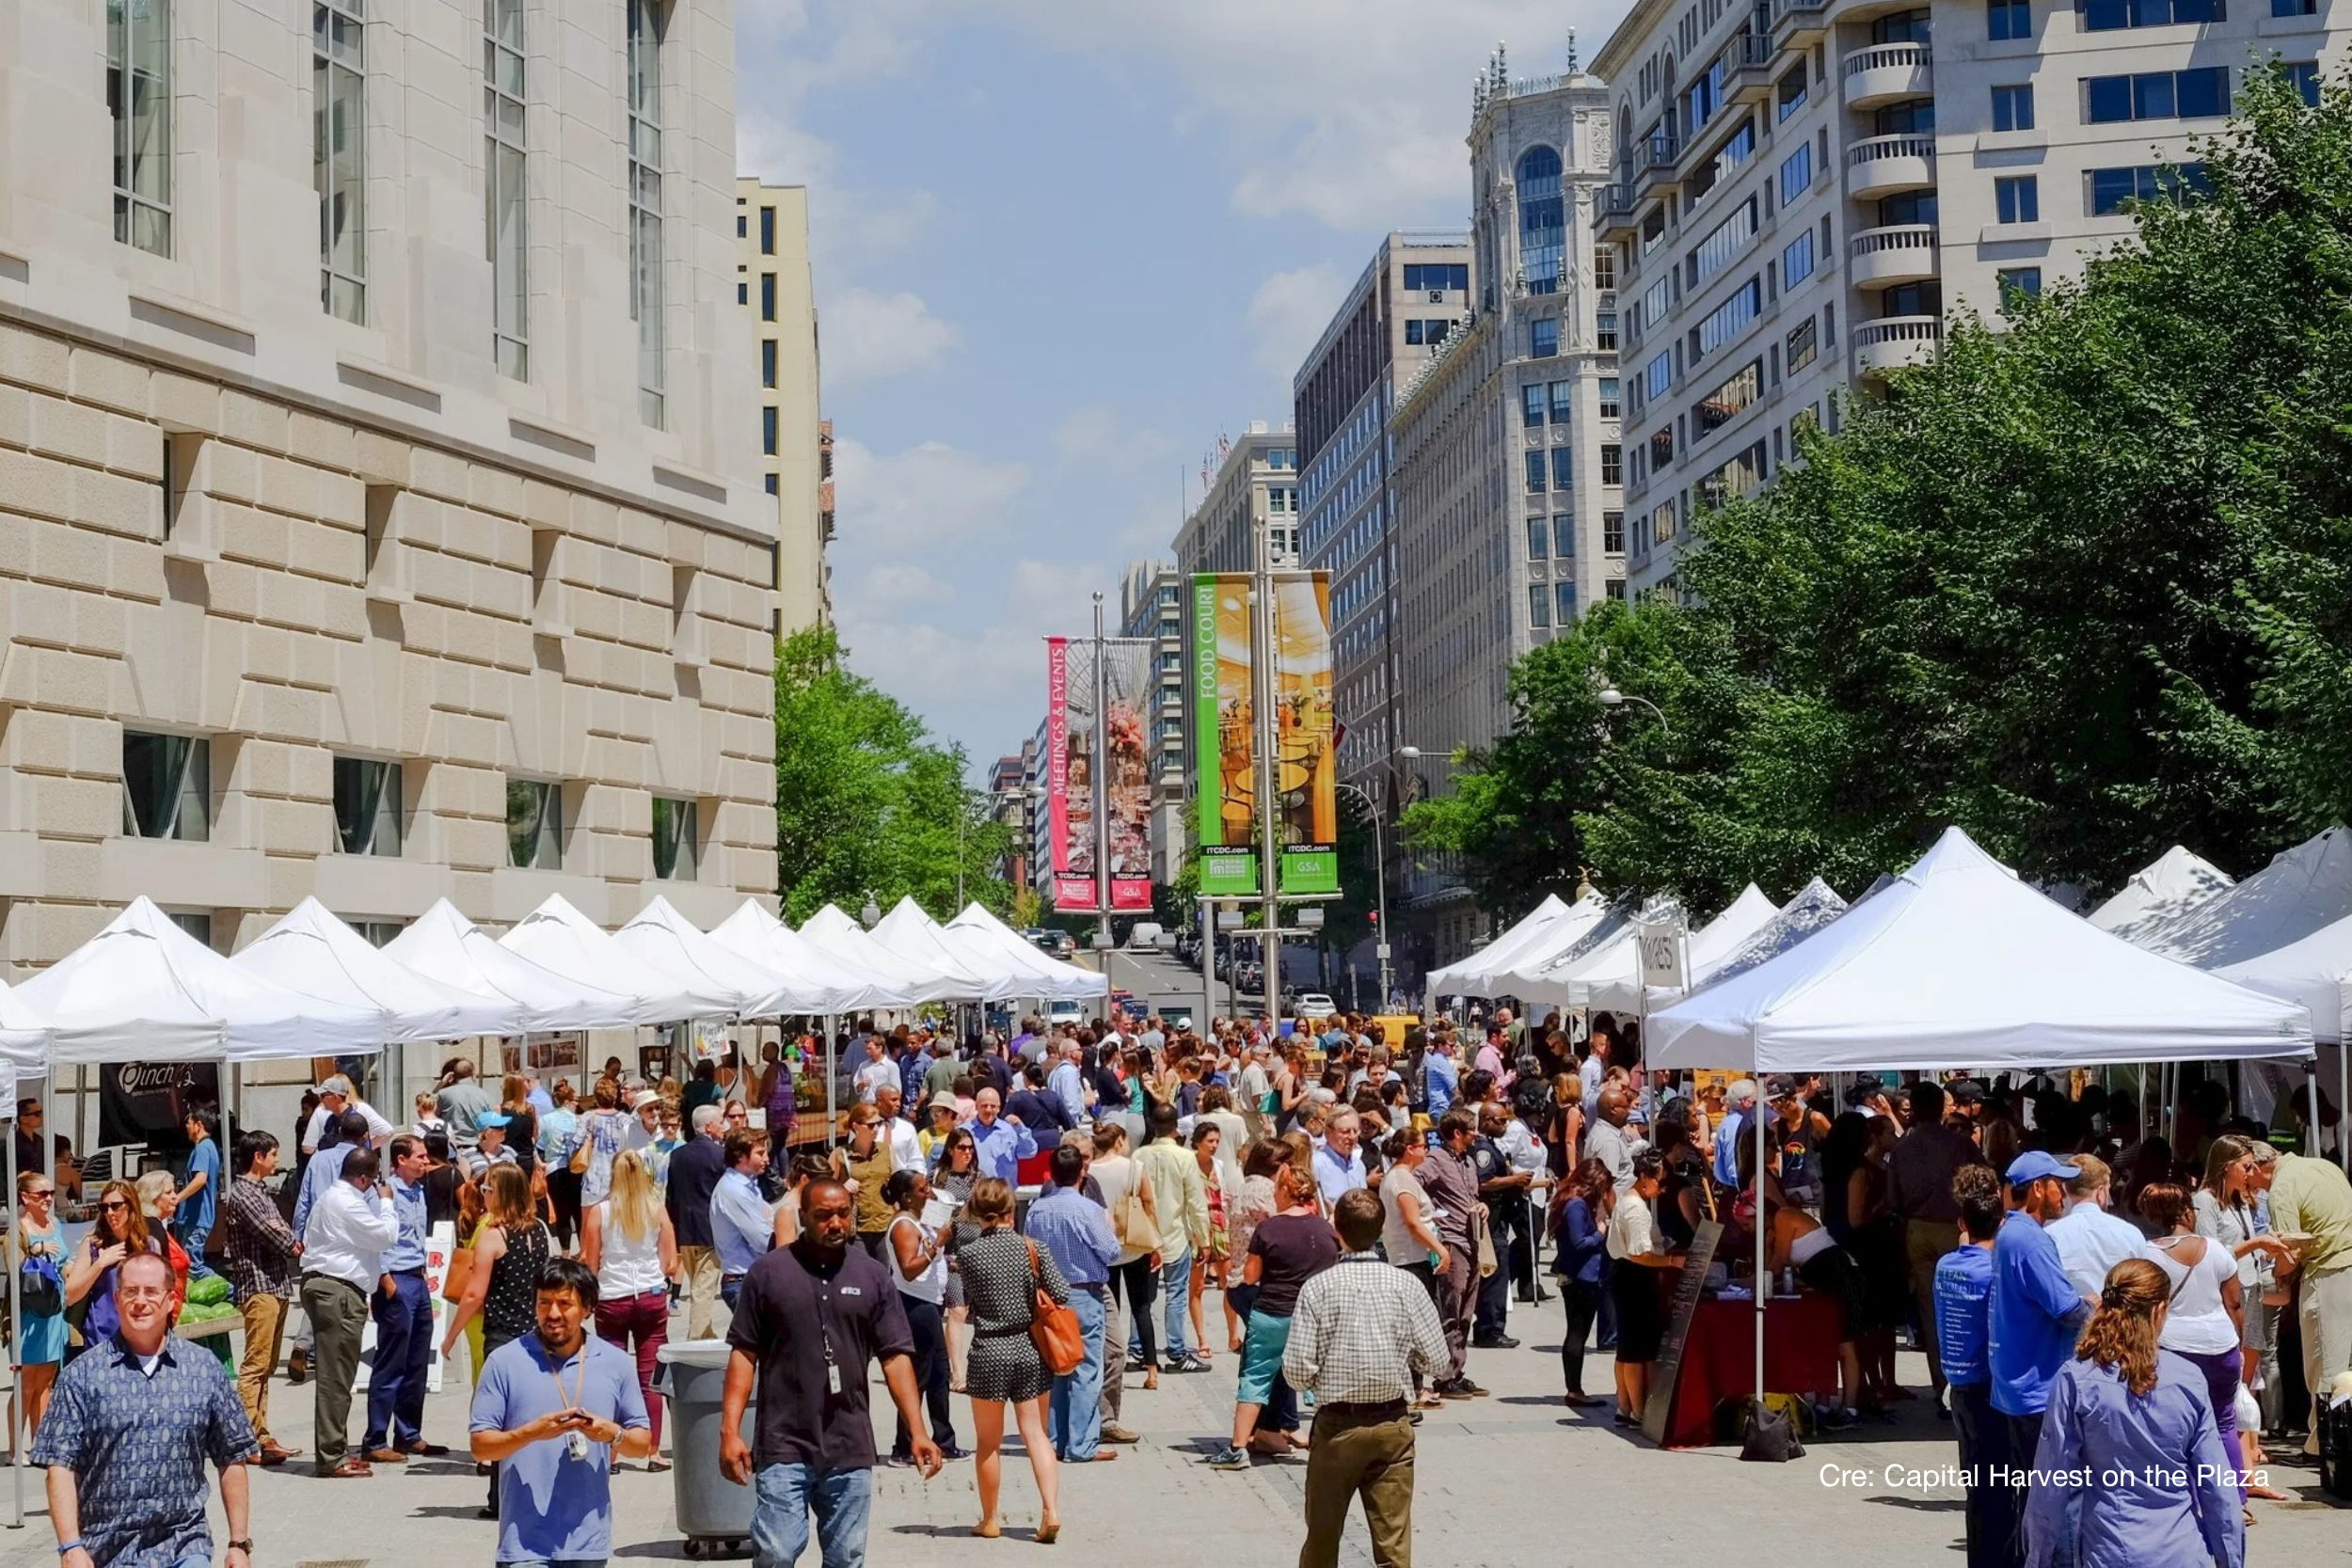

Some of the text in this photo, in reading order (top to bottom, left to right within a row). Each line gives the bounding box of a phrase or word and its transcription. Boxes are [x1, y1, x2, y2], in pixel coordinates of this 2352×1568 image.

[1199, 585, 1216, 699] FOOD COURT
[1053, 647, 1064, 702] EVENTS
[1053, 721, 1065, 796] MEETINGS
[1288, 845, 1330, 853] ITCDC.com
[1297, 861, 1321, 872] GSA
[1123, 887, 1141, 896] GSA
